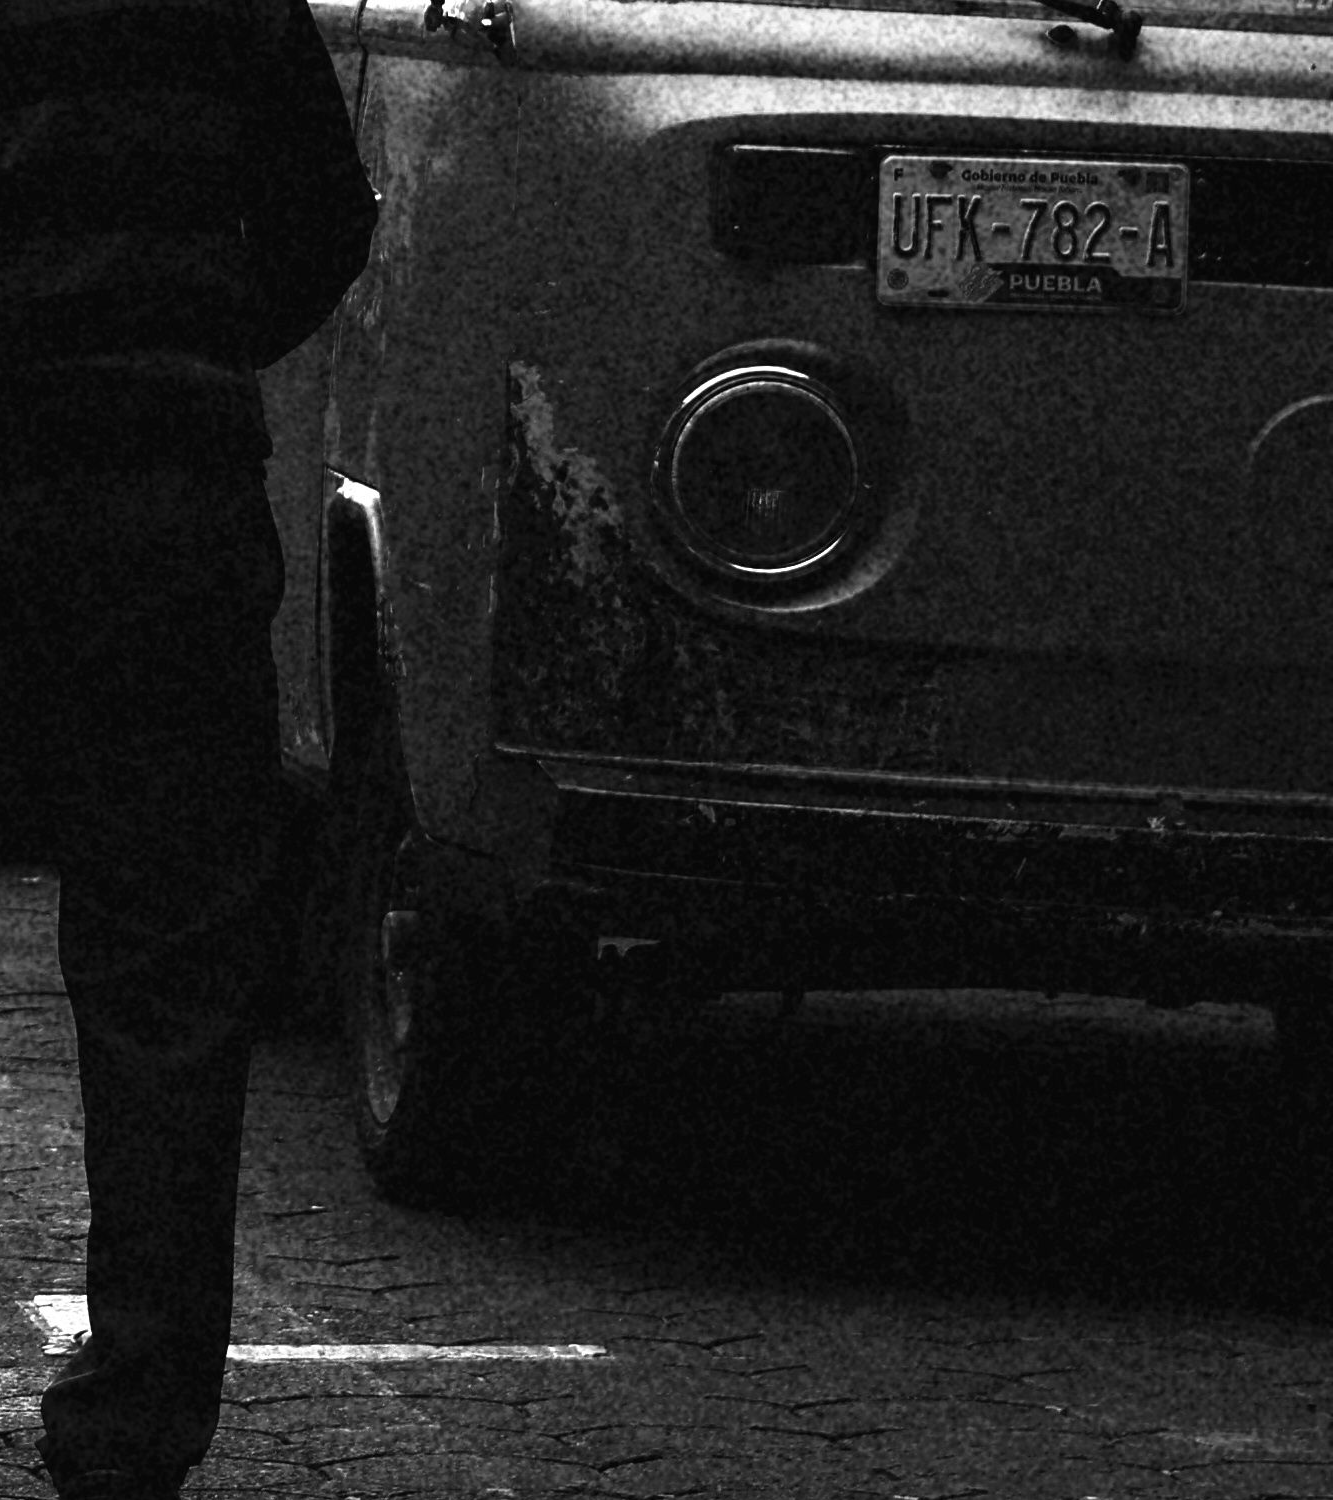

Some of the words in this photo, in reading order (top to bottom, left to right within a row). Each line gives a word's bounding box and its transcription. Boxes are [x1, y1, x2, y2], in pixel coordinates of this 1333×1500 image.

[961, 168, 1025, 183] Gobierno
[1029, 170, 1046, 183] de
[1050, 171, 1098, 185] Puebla
[893, 193, 1174, 268] UFK-782-A
[1009, 273, 1102, 293] PUEBLA
